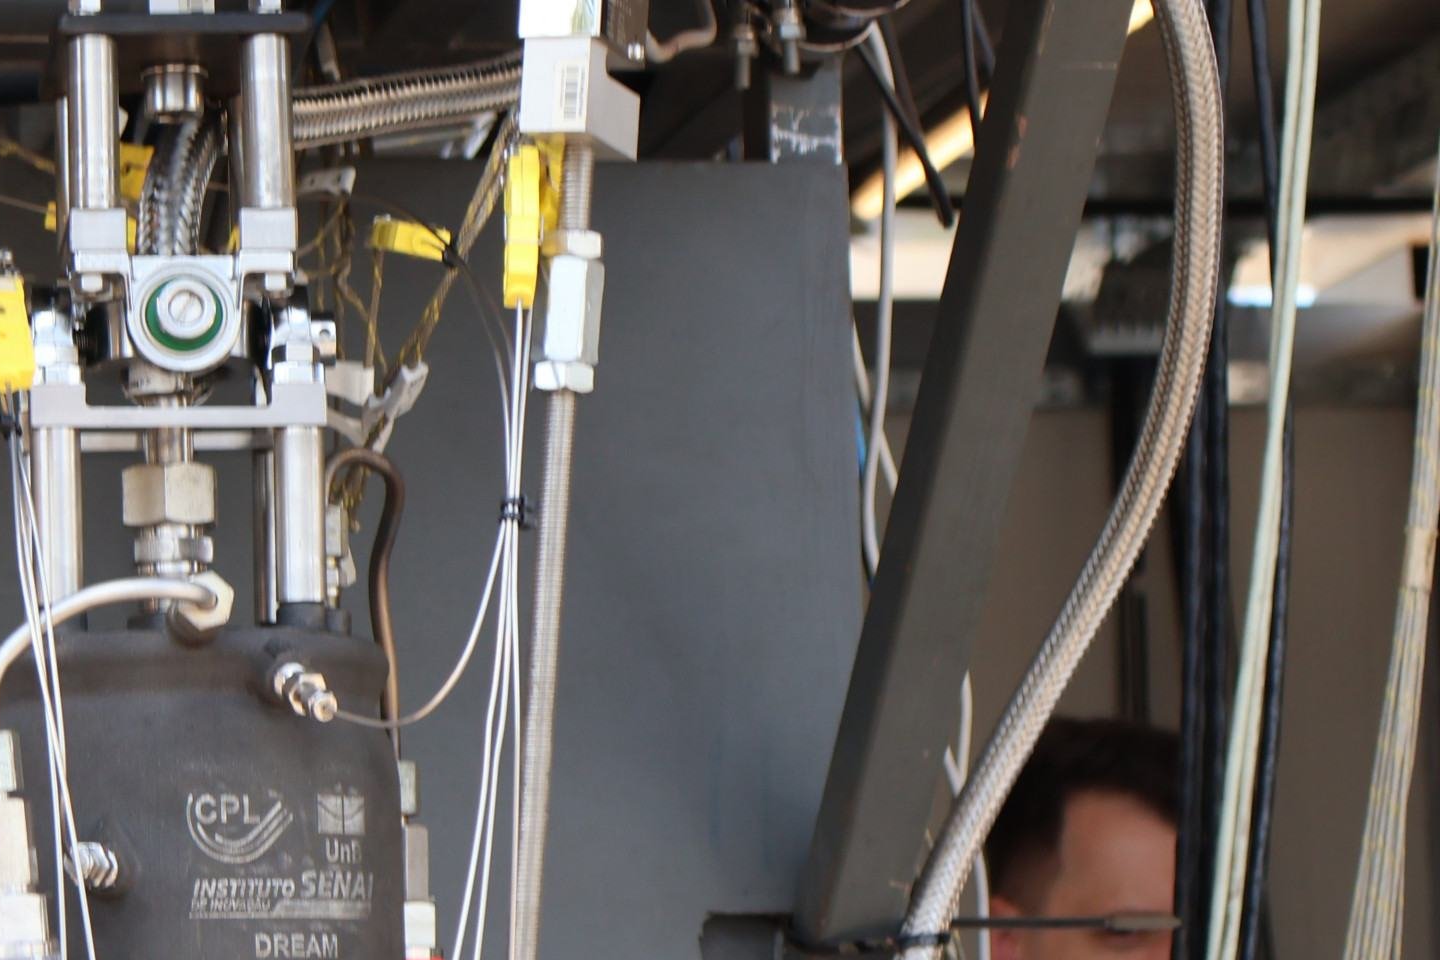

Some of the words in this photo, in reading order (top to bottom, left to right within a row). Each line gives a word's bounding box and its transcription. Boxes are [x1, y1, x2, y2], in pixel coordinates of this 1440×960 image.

[195, 793, 260, 825] CPL
[193, 878, 296, 899] INSTITUTO
[301, 869, 374, 900] SENAI
[255, 933, 339, 959] DREAM
